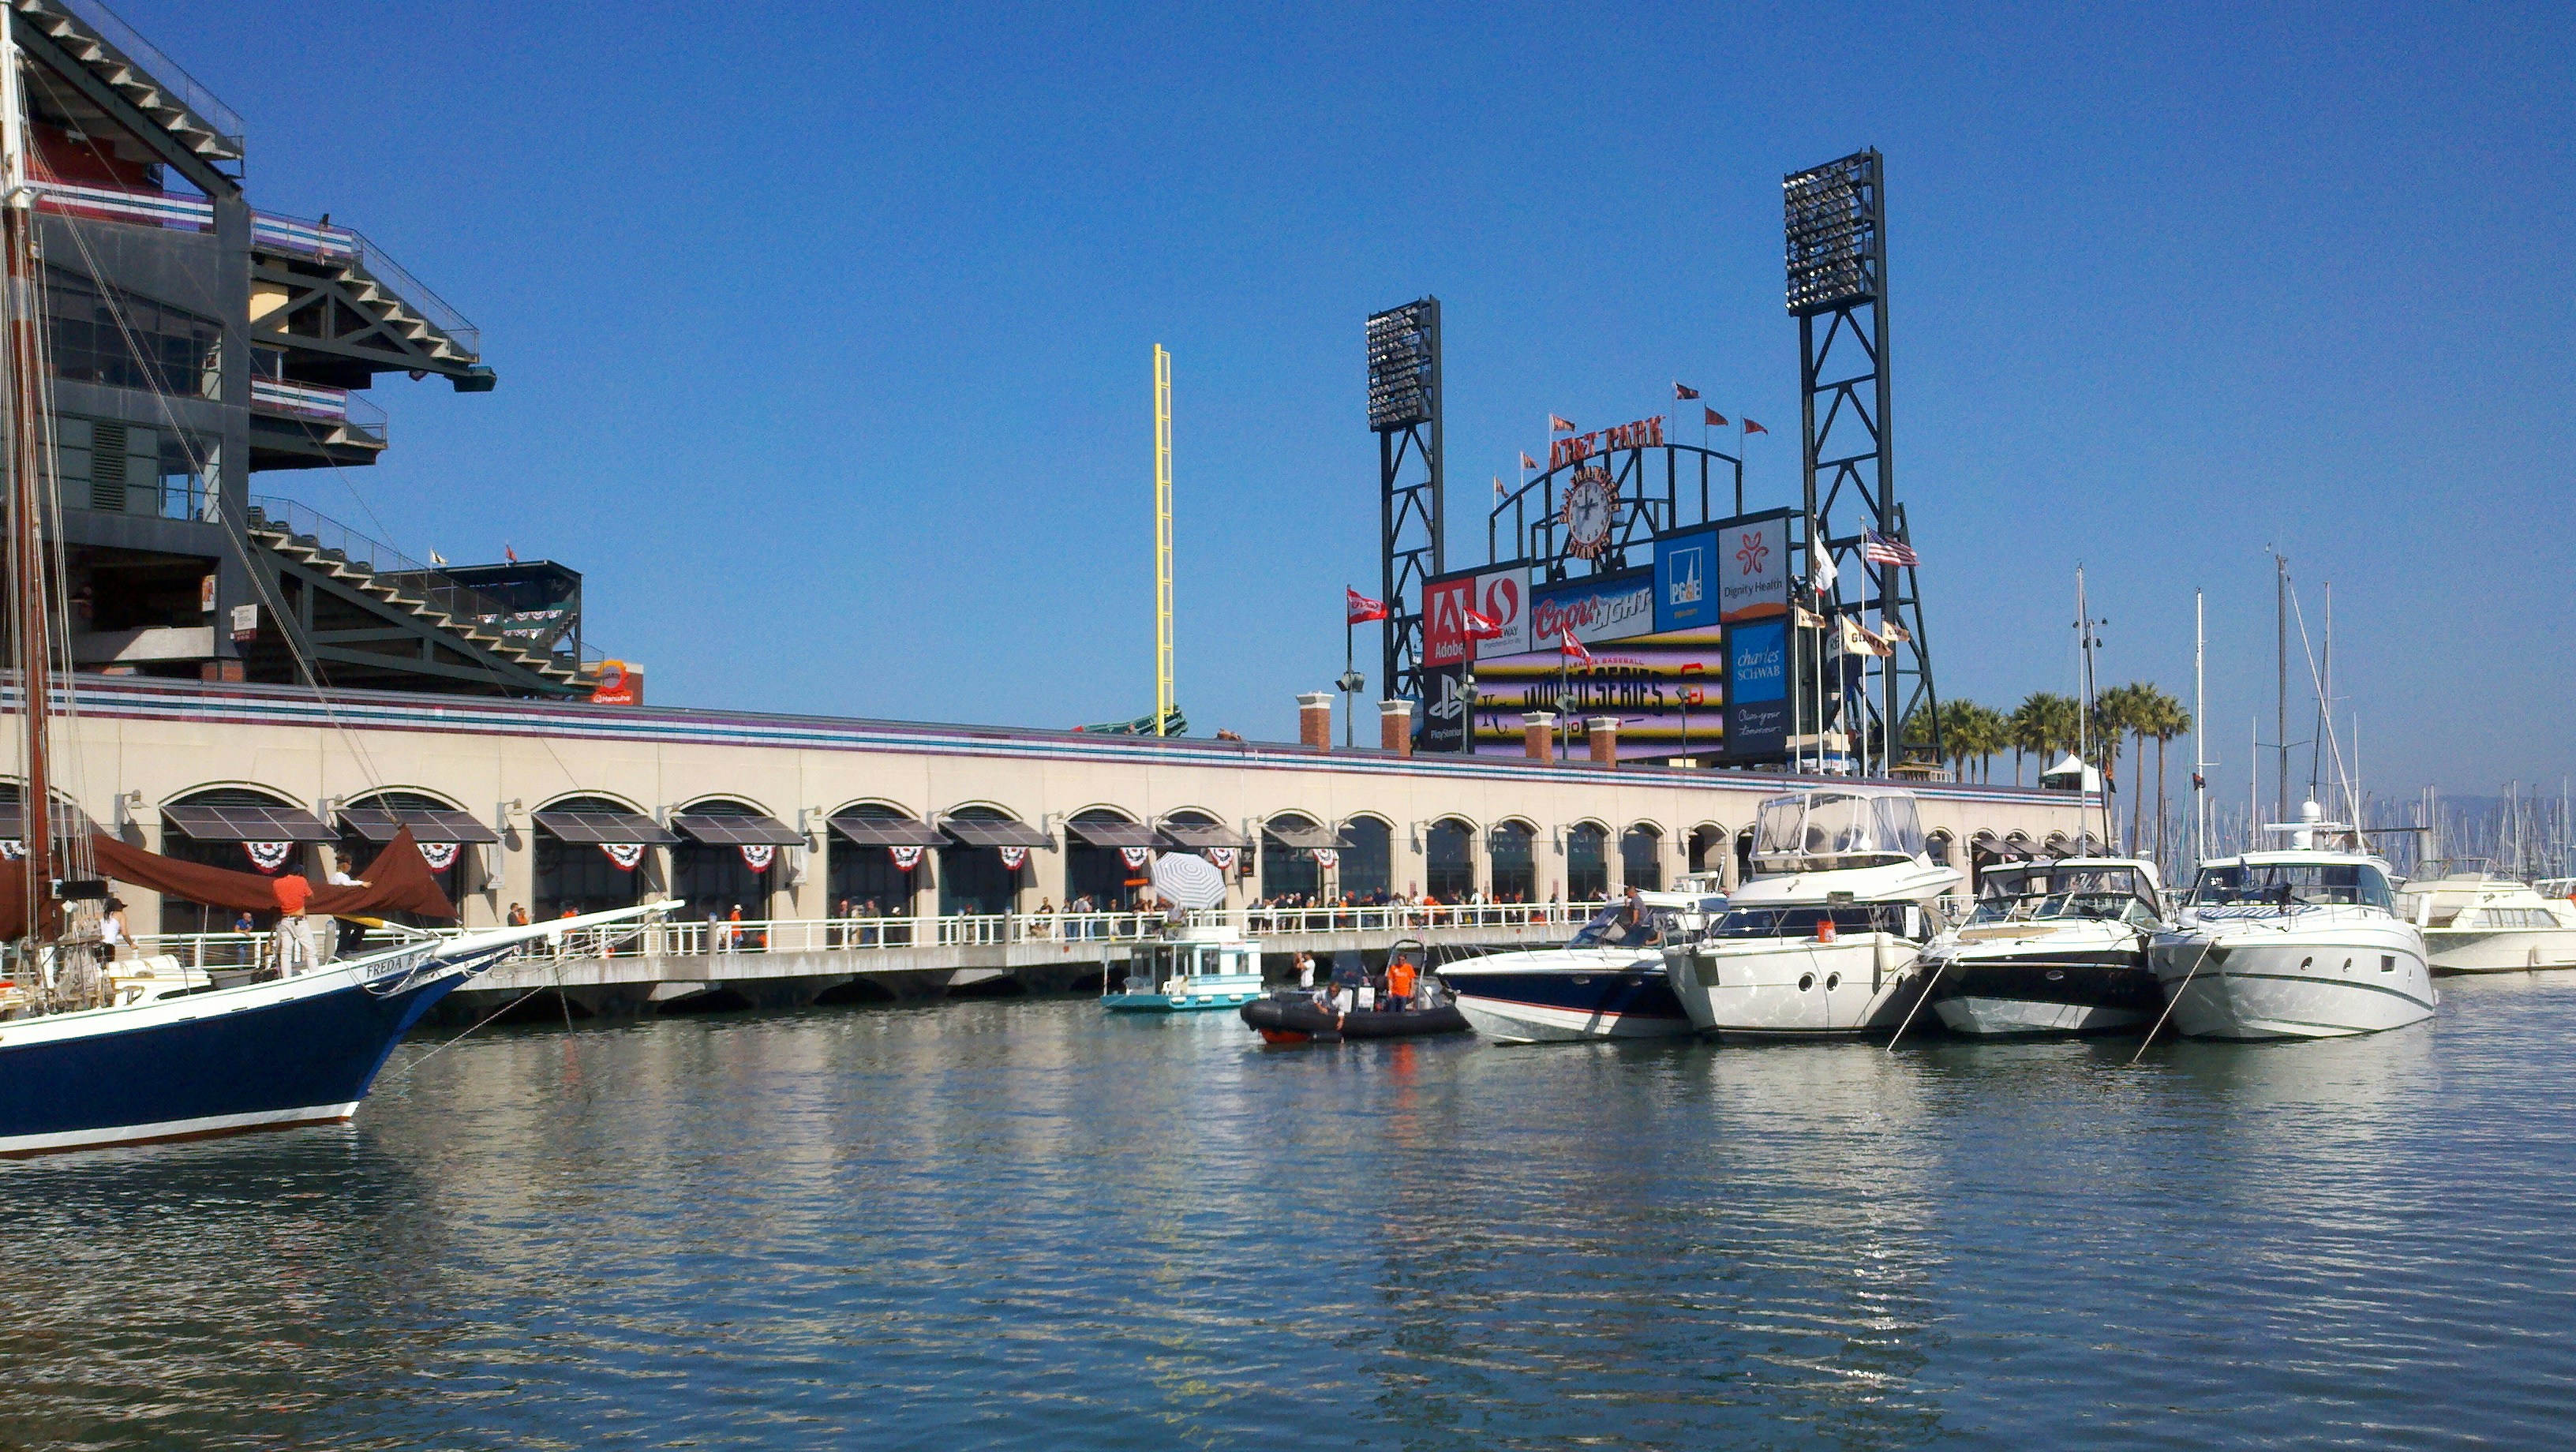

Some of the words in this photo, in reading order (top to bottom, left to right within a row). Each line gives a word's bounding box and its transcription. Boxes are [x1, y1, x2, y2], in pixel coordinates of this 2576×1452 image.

[1548, 431, 1600, 473] AT&T
[1605, 415, 1666, 452] PARK
[1671, 578, 1702, 604] PG&E
[1724, 585, 1754, 600] Dignity
[1754, 577, 1783, 593] Health
[1533, 593, 1598, 640] Coors
[1592, 586, 1652, 632] LIGHT
[1435, 640, 1464, 658] Adobe
[1737, 646, 1780, 667] charles
[1602, 657, 1644, 666] BASEBALL
[1737, 665, 1780, 681] SCHWAB
[1594, 665, 1664, 717] SERIES
[1758, 710, 1781, 726] your
[367, 956, 402, 978] FREDA
[408, 953, 414, 966] B
